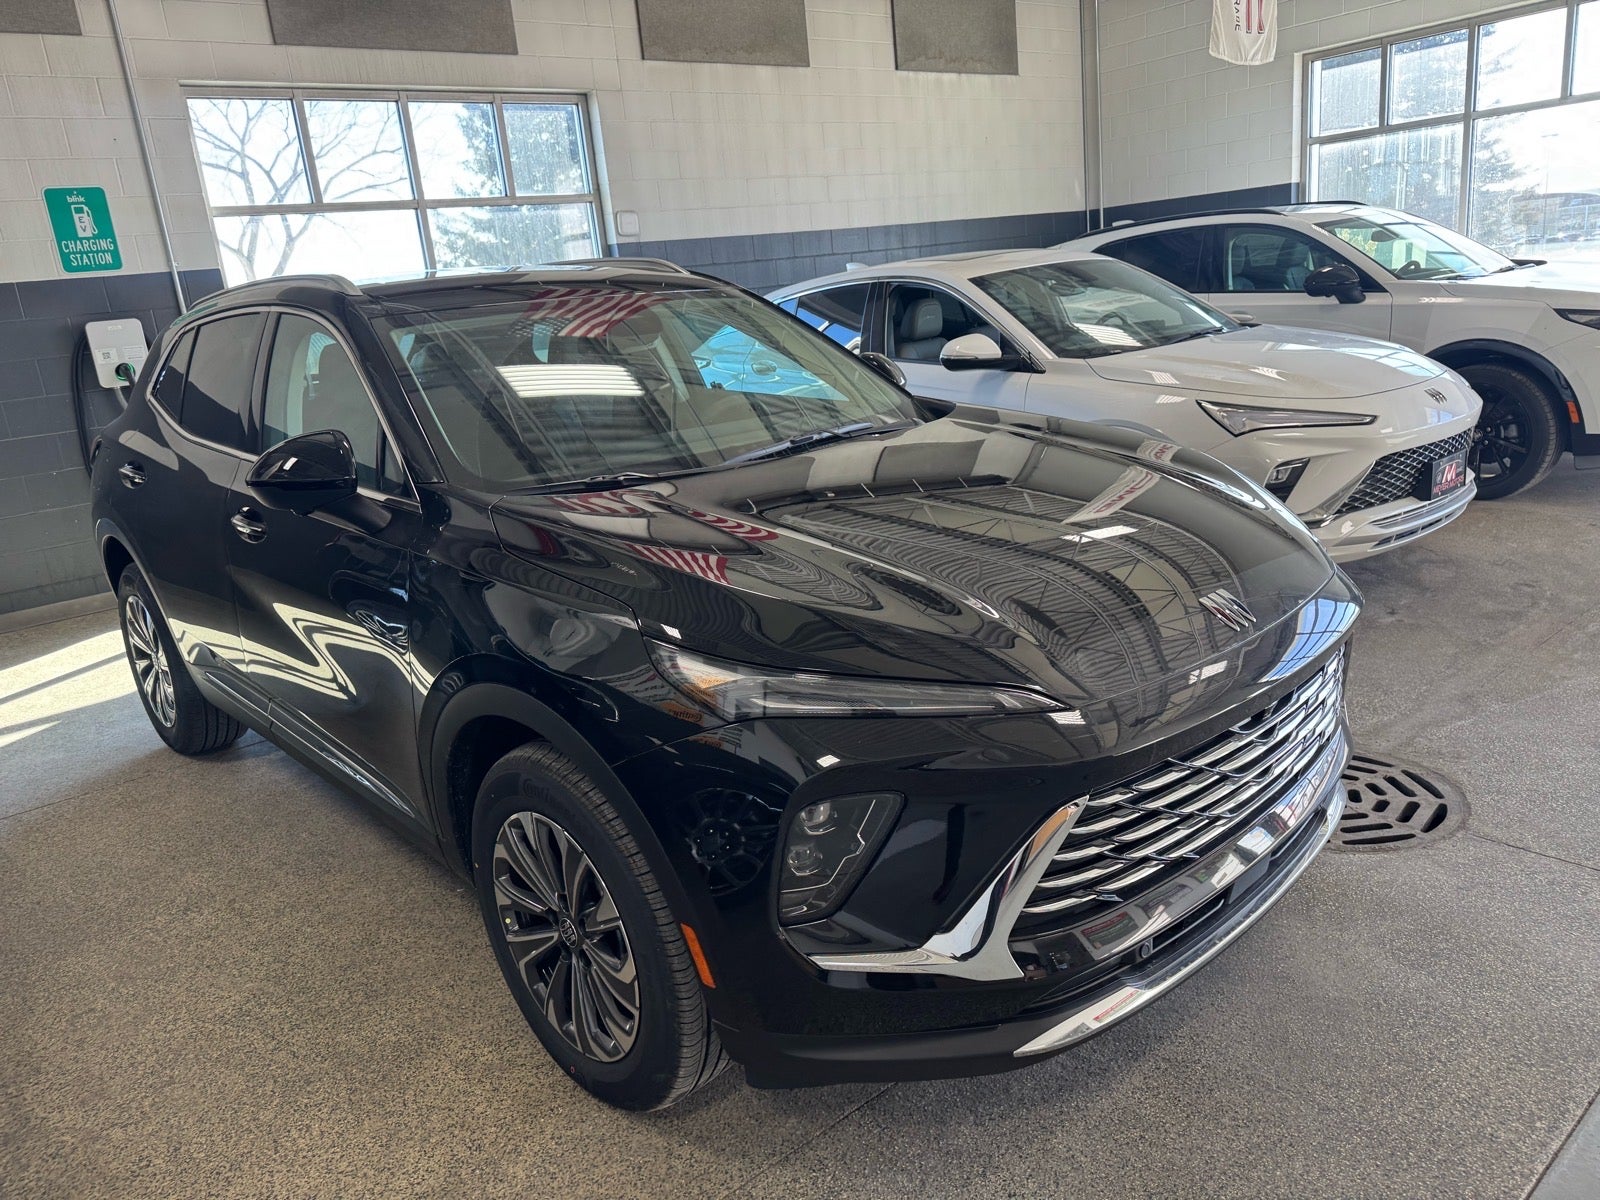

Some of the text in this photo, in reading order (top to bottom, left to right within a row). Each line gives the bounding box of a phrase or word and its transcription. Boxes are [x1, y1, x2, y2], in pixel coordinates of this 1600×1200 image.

[67, 195, 85, 203] blink
[61, 239, 114, 253] CHARGING
[70, 252, 112, 266] STATION
